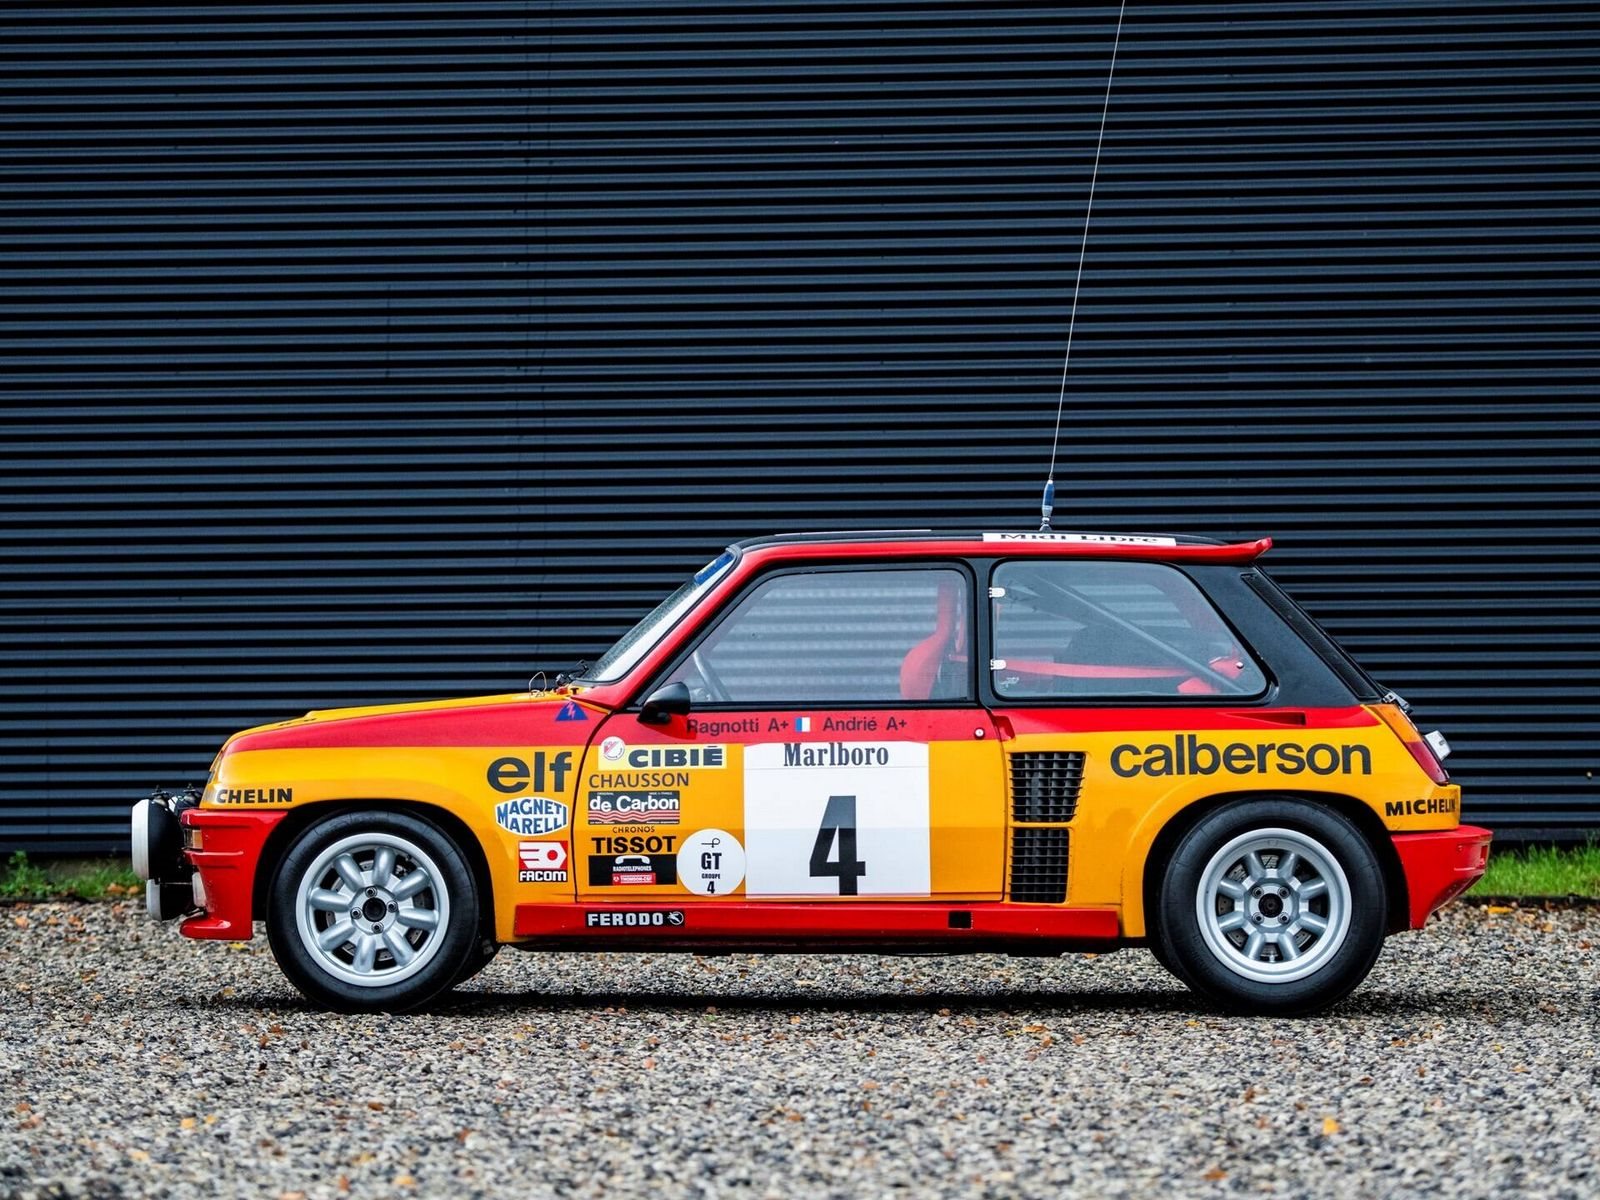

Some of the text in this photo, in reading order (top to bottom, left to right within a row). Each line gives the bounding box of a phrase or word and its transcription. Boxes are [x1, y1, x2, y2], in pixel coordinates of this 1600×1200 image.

[686, 717, 789, 736] Ragnotti A+
[822, 716, 907, 731] Andrié A+
[628, 745, 723, 768] CIBIÉ
[783, 742, 889, 766] Marlboro
[1109, 734, 1372, 778] calberson
[487, 751, 572, 793] elf
[588, 772, 689, 789] CHAUSSON
[216, 788, 293, 804] CHELIN
[589, 795, 679, 812] de Carbon
[496, 798, 567, 821] MAGNETI
[1385, 798, 1456, 816] MICHELIN
[497, 812, 567, 835] MARELLI
[612, 826, 656, 834] CHRONOS
[591, 836, 677, 854] TISSOT
[809, 795, 866, 897] 4
[701, 852, 722, 870] GT
[519, 870, 567, 882] FACOM
[707, 881, 715, 894] 4
[587, 912, 664, 926] FERODO
